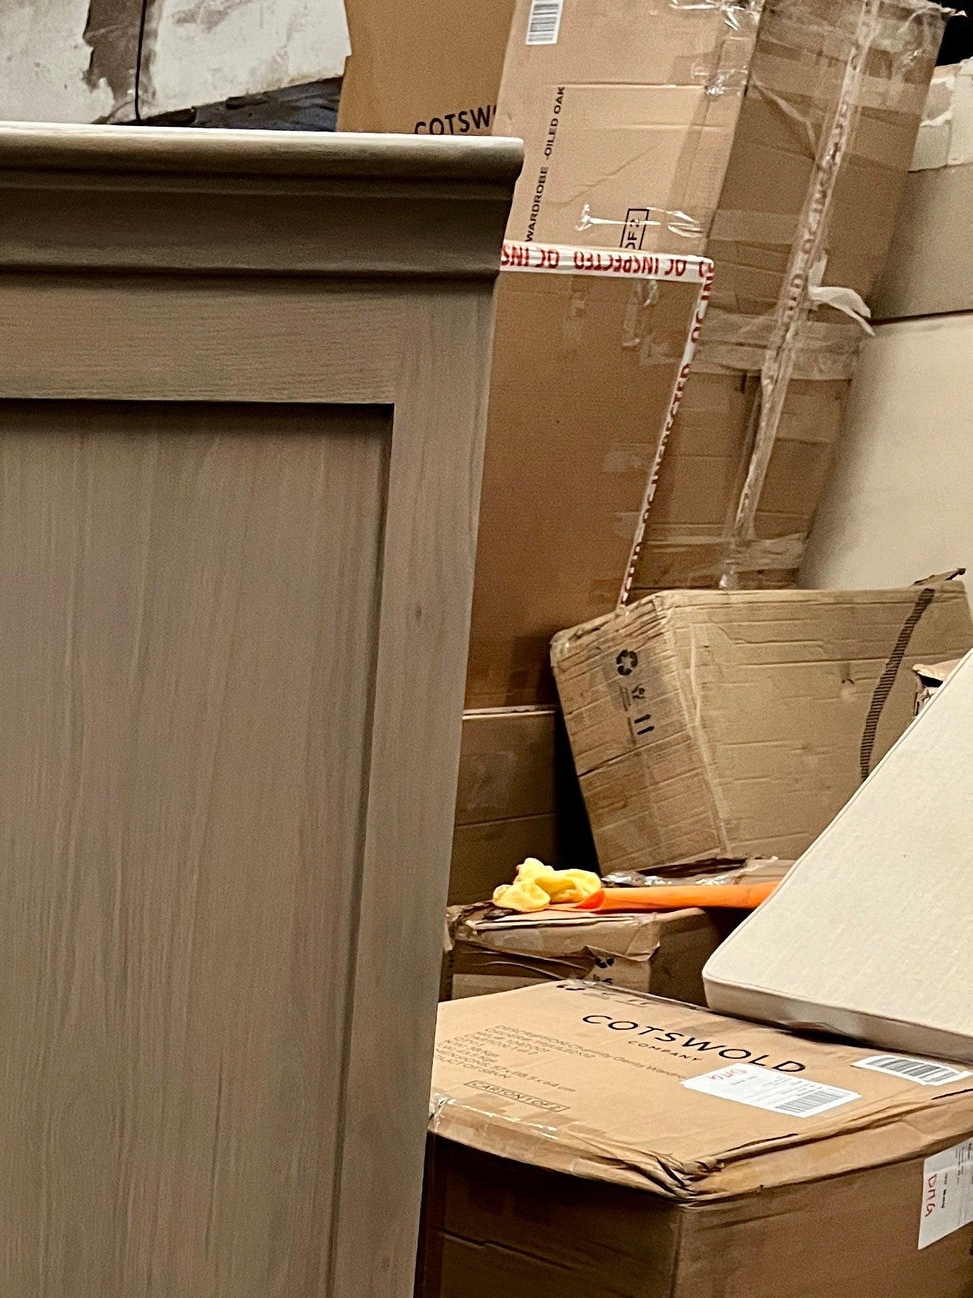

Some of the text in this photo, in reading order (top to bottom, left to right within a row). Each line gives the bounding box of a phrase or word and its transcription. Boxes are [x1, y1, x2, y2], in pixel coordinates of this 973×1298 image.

[415, 105, 496, 135] COTSW
[525, 166, 549, 242] WARDROBE
[554, 87, 565, 115] OAK
[573, 250, 660, 275] INSPECTED
[582, 1014, 806, 1073] COTSWOLD
[627, 1040, 703, 1062] COMPANY
